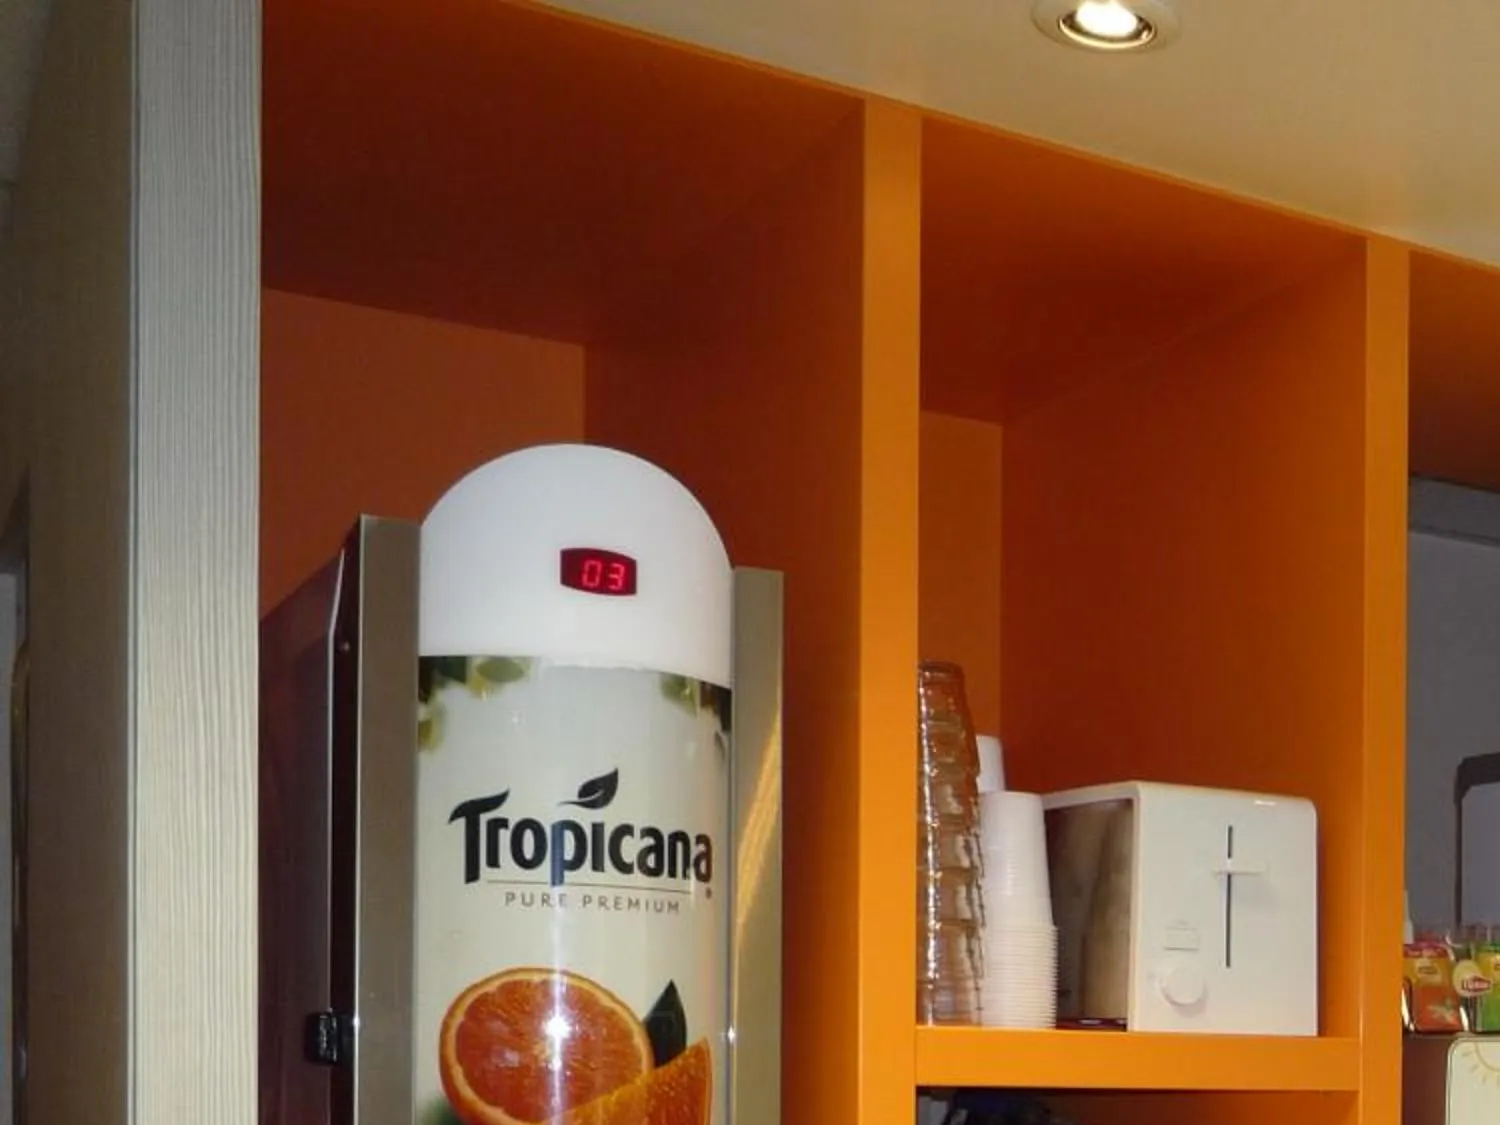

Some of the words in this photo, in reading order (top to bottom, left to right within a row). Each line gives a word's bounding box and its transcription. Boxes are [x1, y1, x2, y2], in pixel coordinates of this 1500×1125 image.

[581, 559, 625, 590] 03
[448, 788, 713, 887] Tropicana
[505, 891, 568, 908] PURE
[583, 895, 681, 914] PREMIUM
